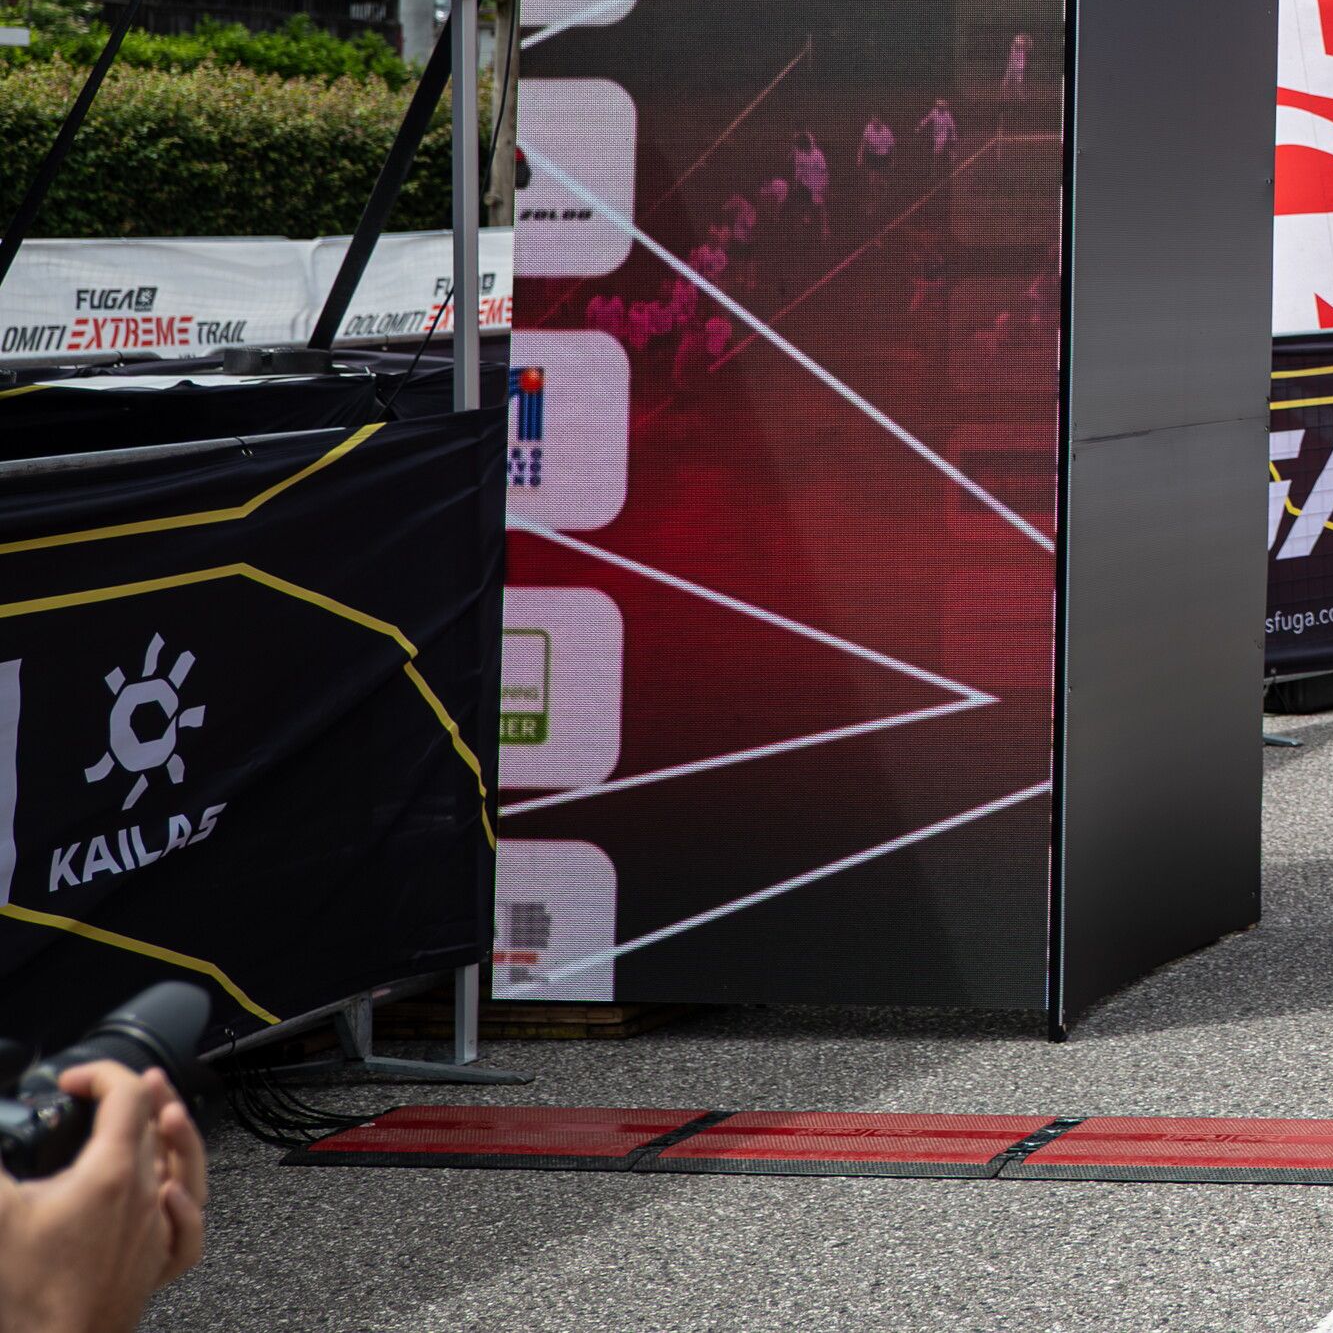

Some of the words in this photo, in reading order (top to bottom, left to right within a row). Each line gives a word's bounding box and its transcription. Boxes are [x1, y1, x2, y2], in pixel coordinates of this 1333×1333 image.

[75, 288, 135, 311] FUGA
[1, 324, 67, 353] OMITI
[67, 316, 193, 351] EXTREME
[196, 320, 247, 345] TRAIL
[49, 802, 228, 892] KAILAS
